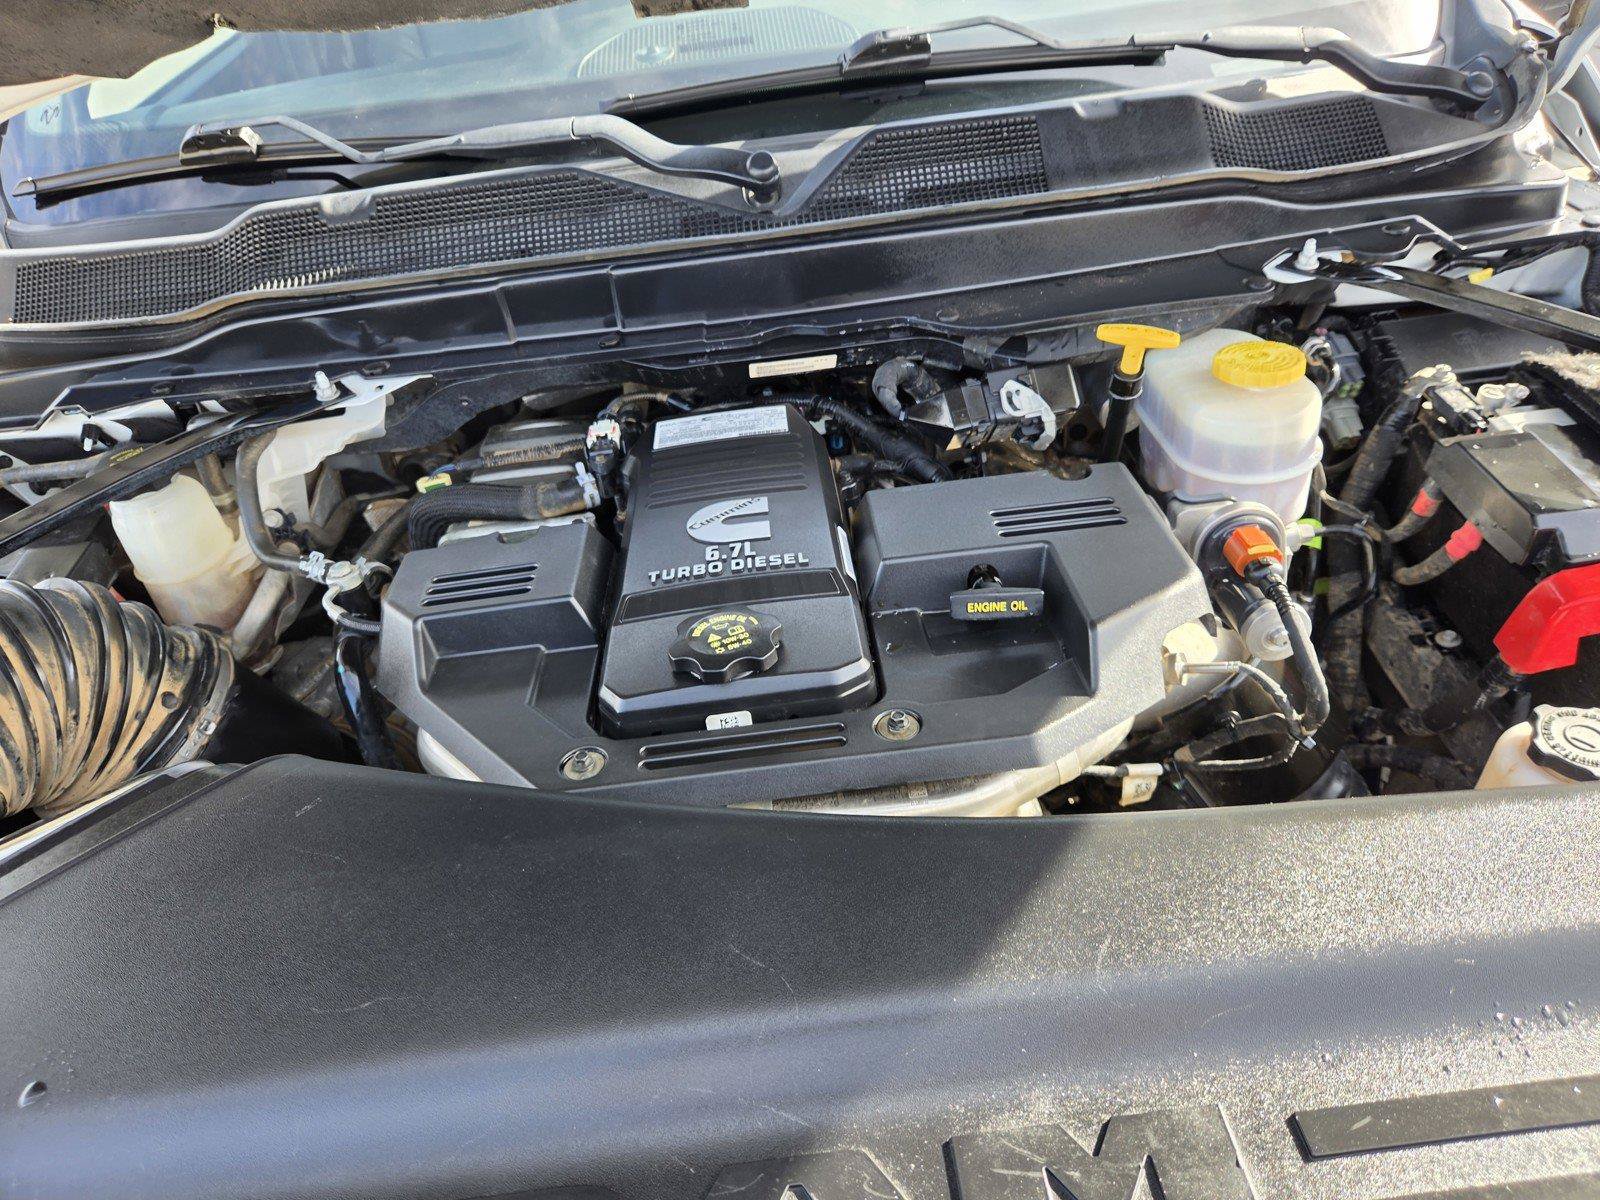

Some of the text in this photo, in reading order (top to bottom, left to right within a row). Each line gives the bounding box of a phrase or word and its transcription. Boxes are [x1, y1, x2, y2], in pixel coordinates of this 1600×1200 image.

[705, 541, 757, 562] 6.7L
[648, 551, 810, 584] TURBO DIESEL
[967, 600, 1028, 613] ENGINE OIL
[722, 632, 749, 644] 10W-30
